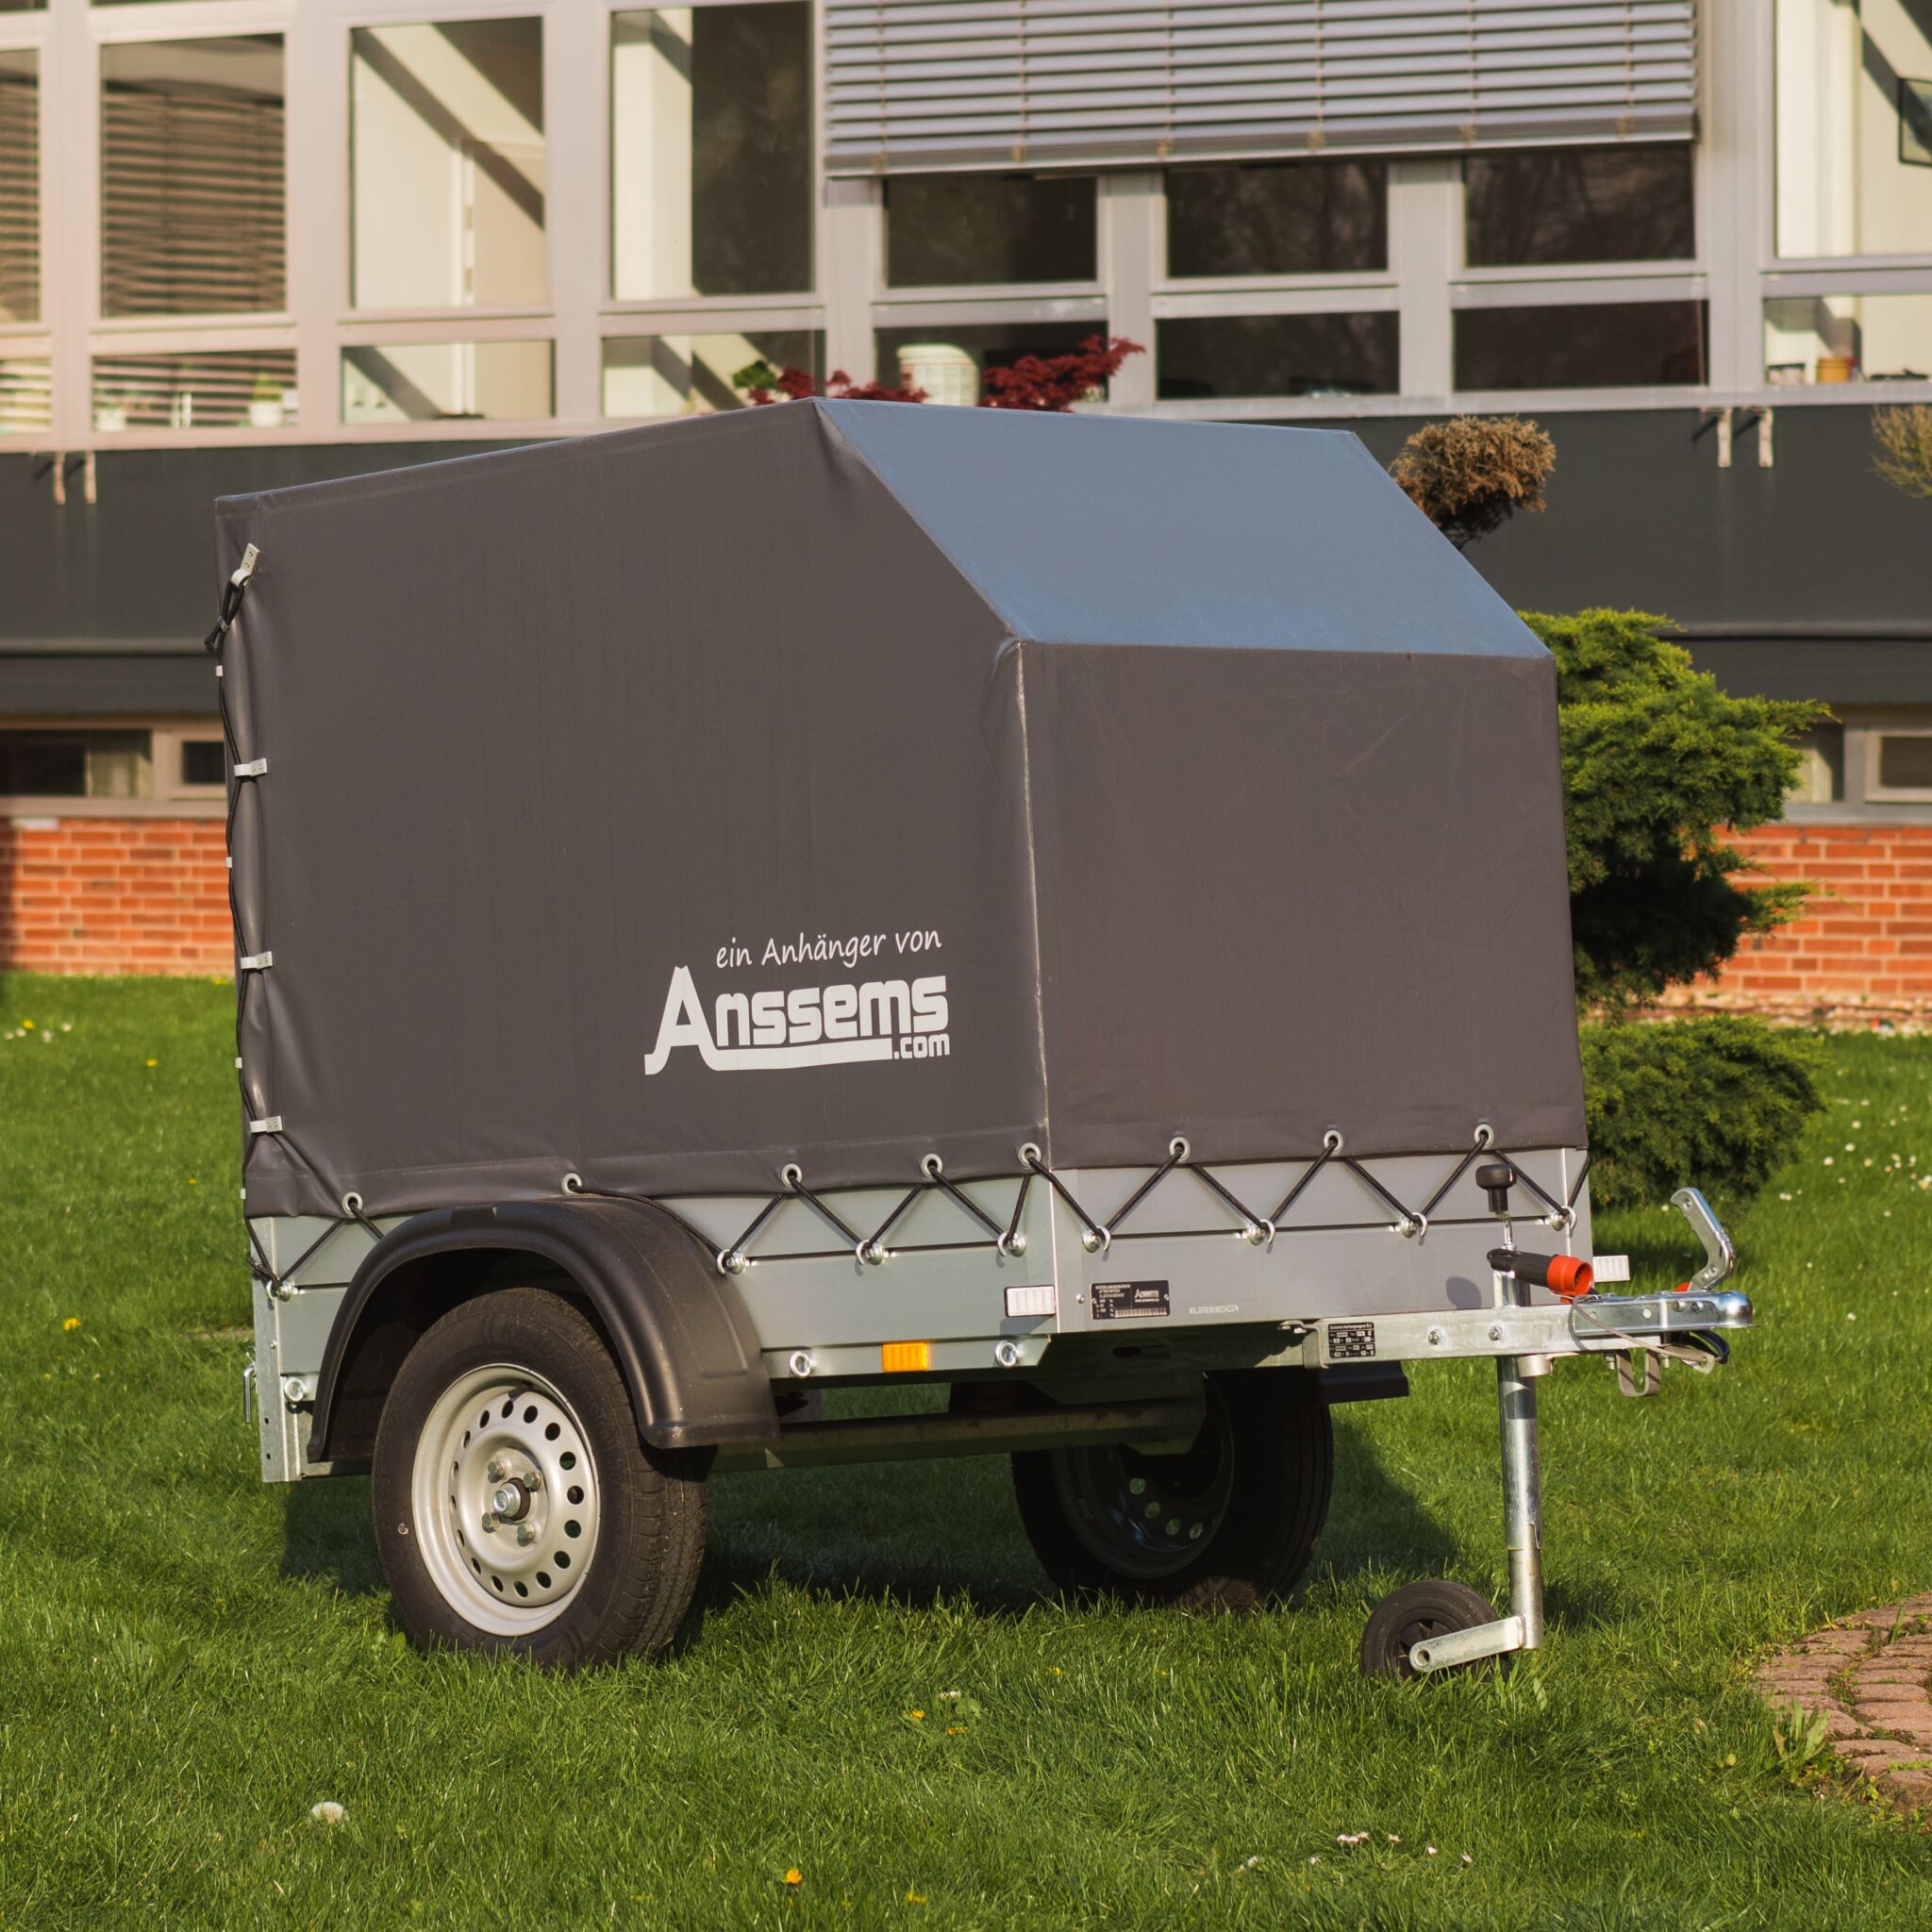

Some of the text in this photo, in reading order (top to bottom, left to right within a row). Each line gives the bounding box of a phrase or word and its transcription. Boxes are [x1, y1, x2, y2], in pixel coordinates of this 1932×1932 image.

[716, 930, 942, 969] ein Anhänger von
[644, 965, 949, 1075] Anssems
[893, 1033, 951, 1060] .com
